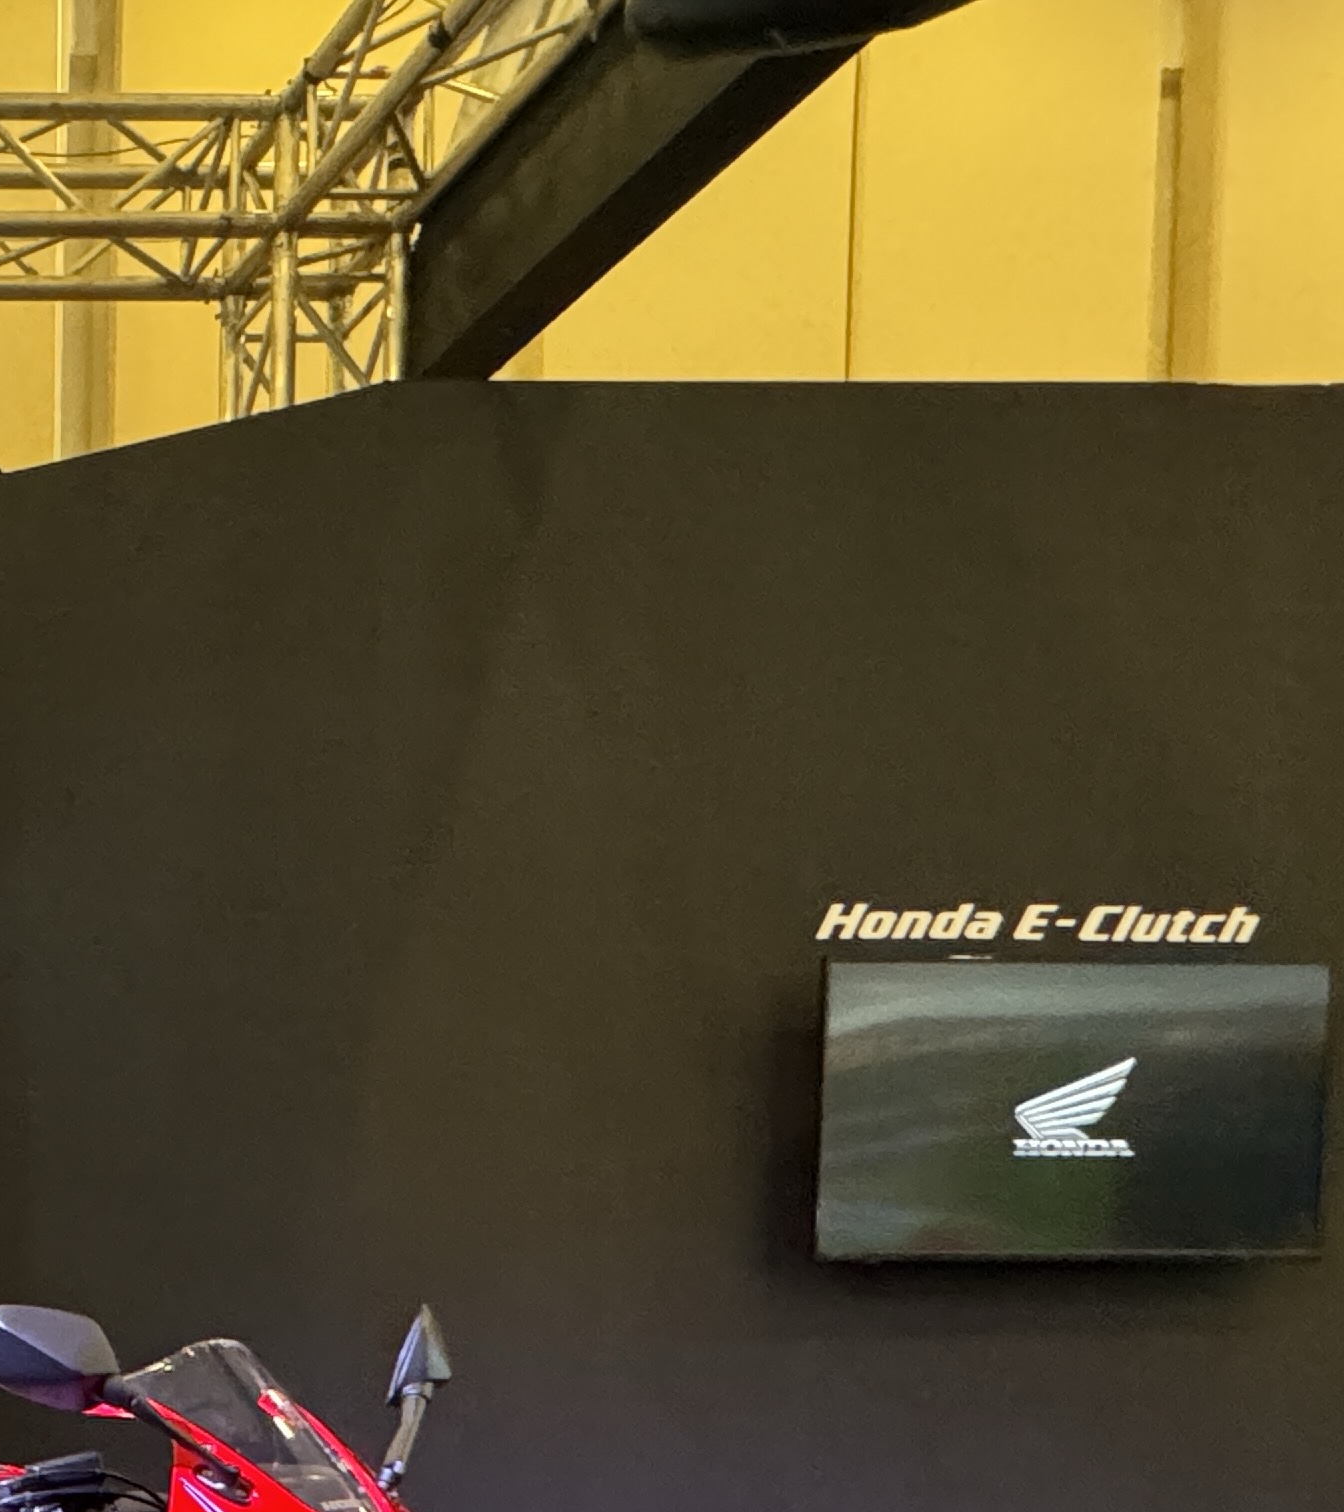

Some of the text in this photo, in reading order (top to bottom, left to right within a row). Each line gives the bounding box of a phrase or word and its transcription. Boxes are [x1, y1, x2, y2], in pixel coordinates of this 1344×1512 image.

[815, 902, 1261, 944] Honda E-Clutch
[1012, 1137, 1136, 1157] HONDA
